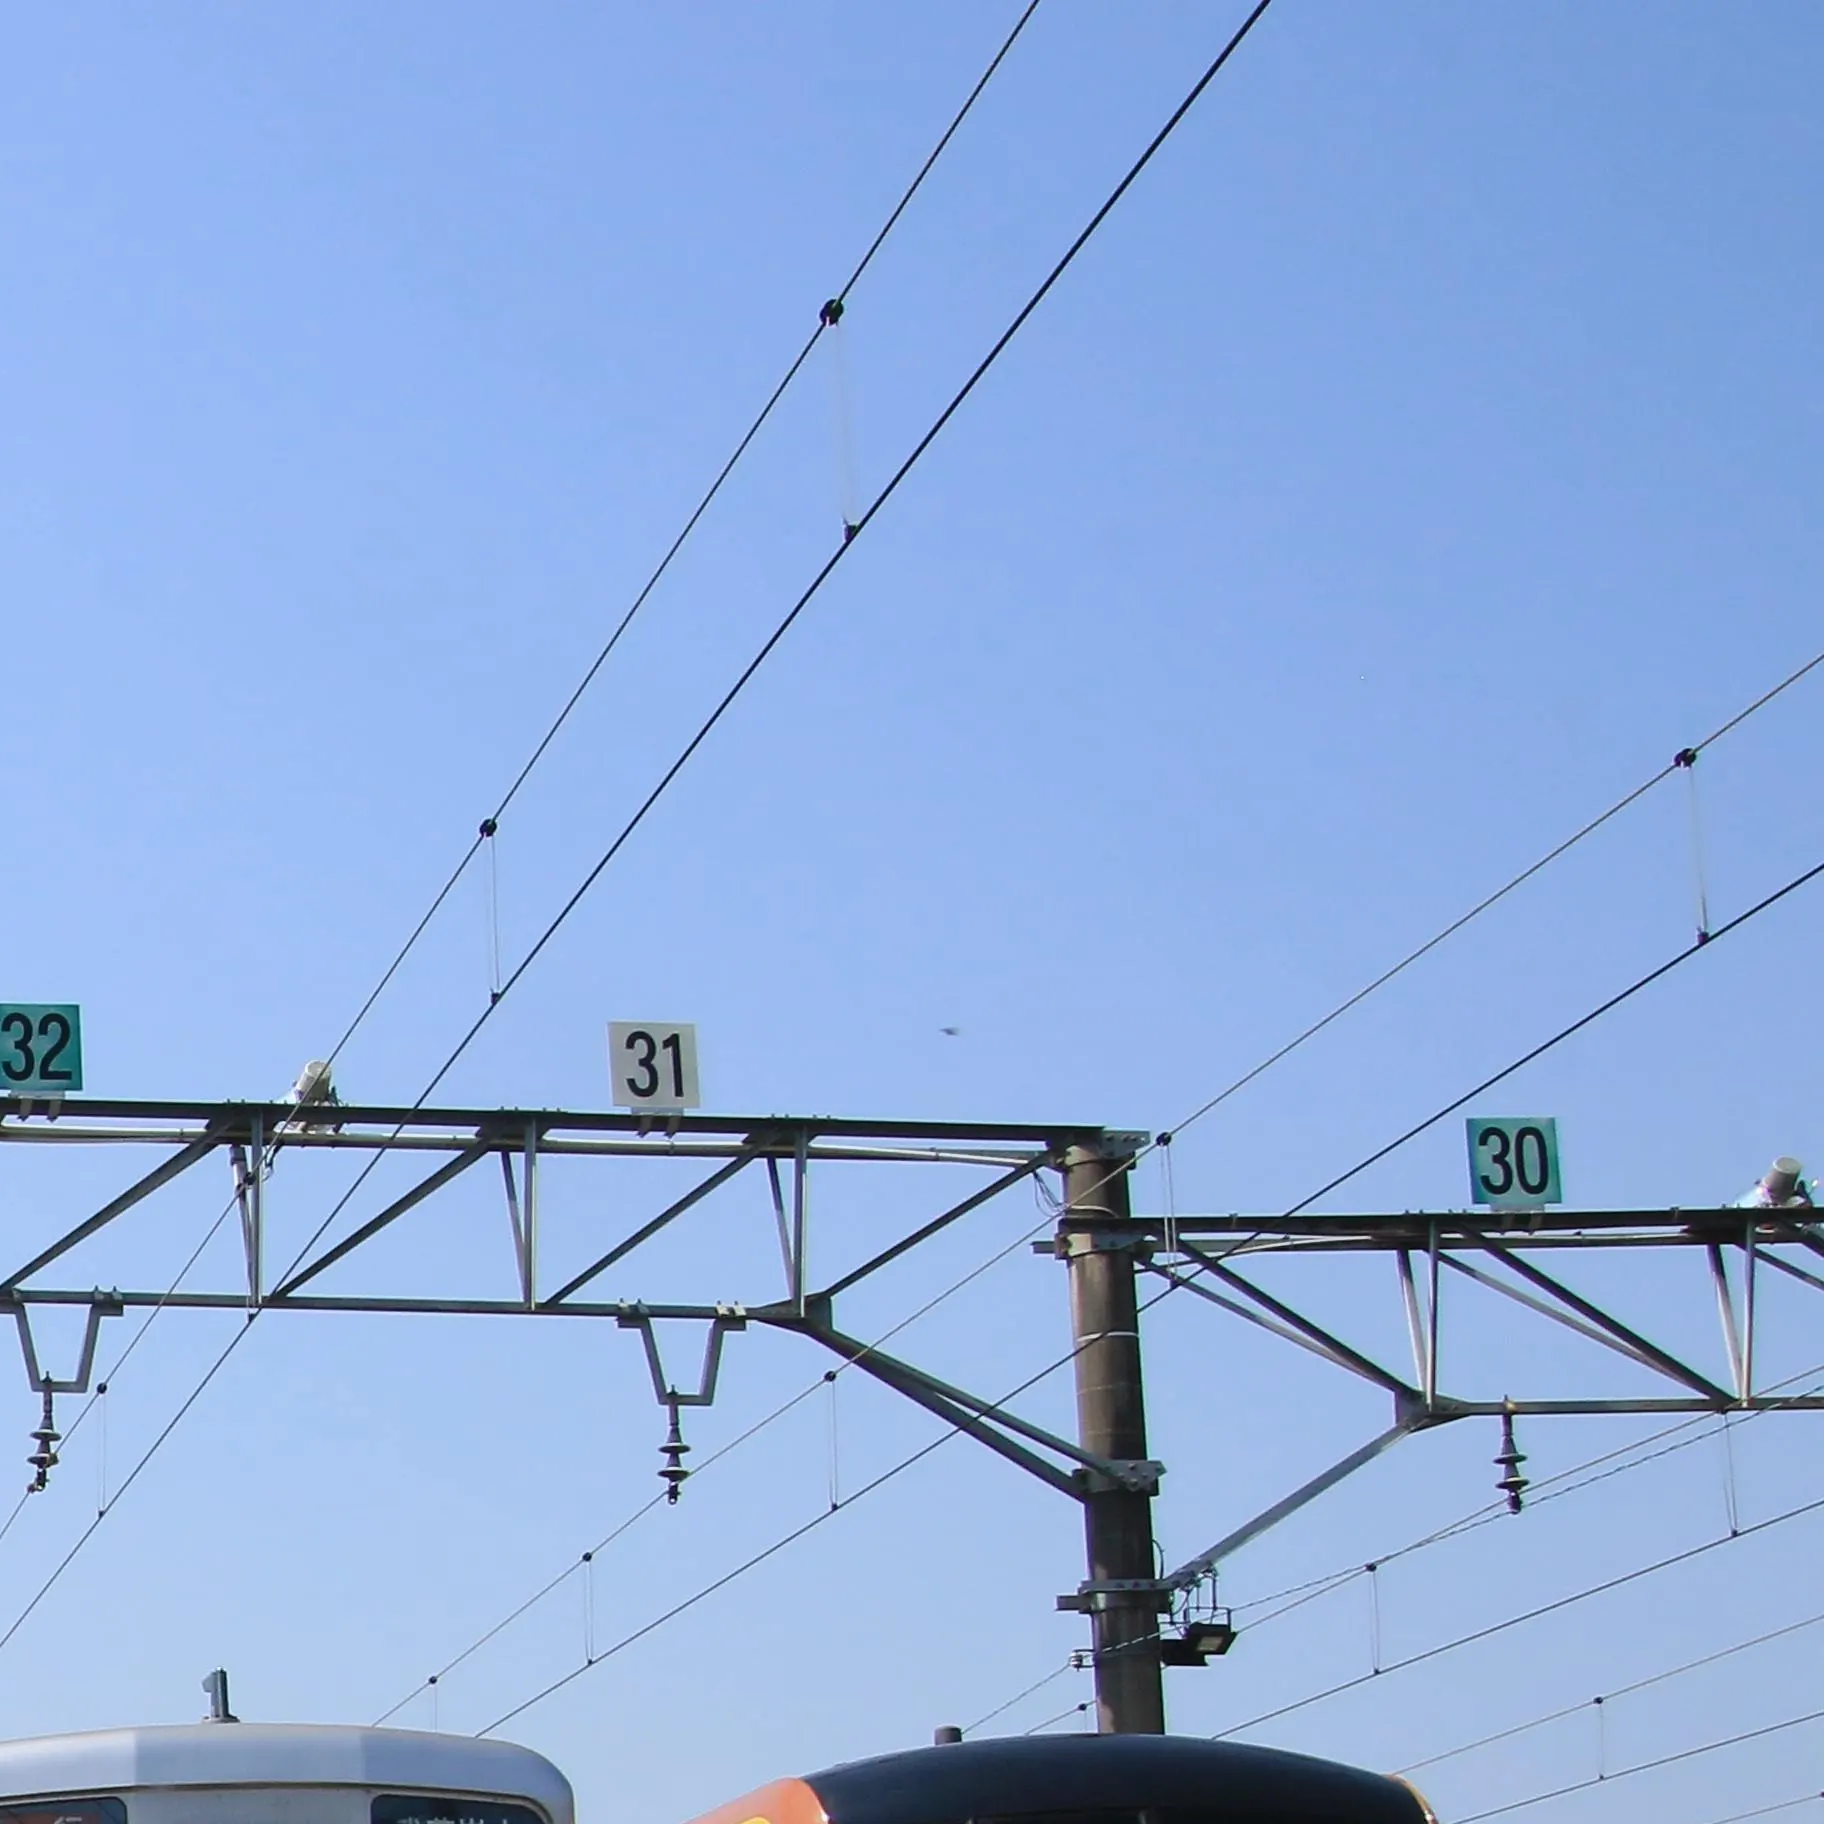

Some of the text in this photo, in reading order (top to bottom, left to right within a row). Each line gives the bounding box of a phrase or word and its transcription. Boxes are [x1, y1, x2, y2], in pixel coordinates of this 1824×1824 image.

[1, 1012, 72, 1080] 32
[626, 1030, 682, 1097] 31
[1479, 1126, 1548, 1194] 30
